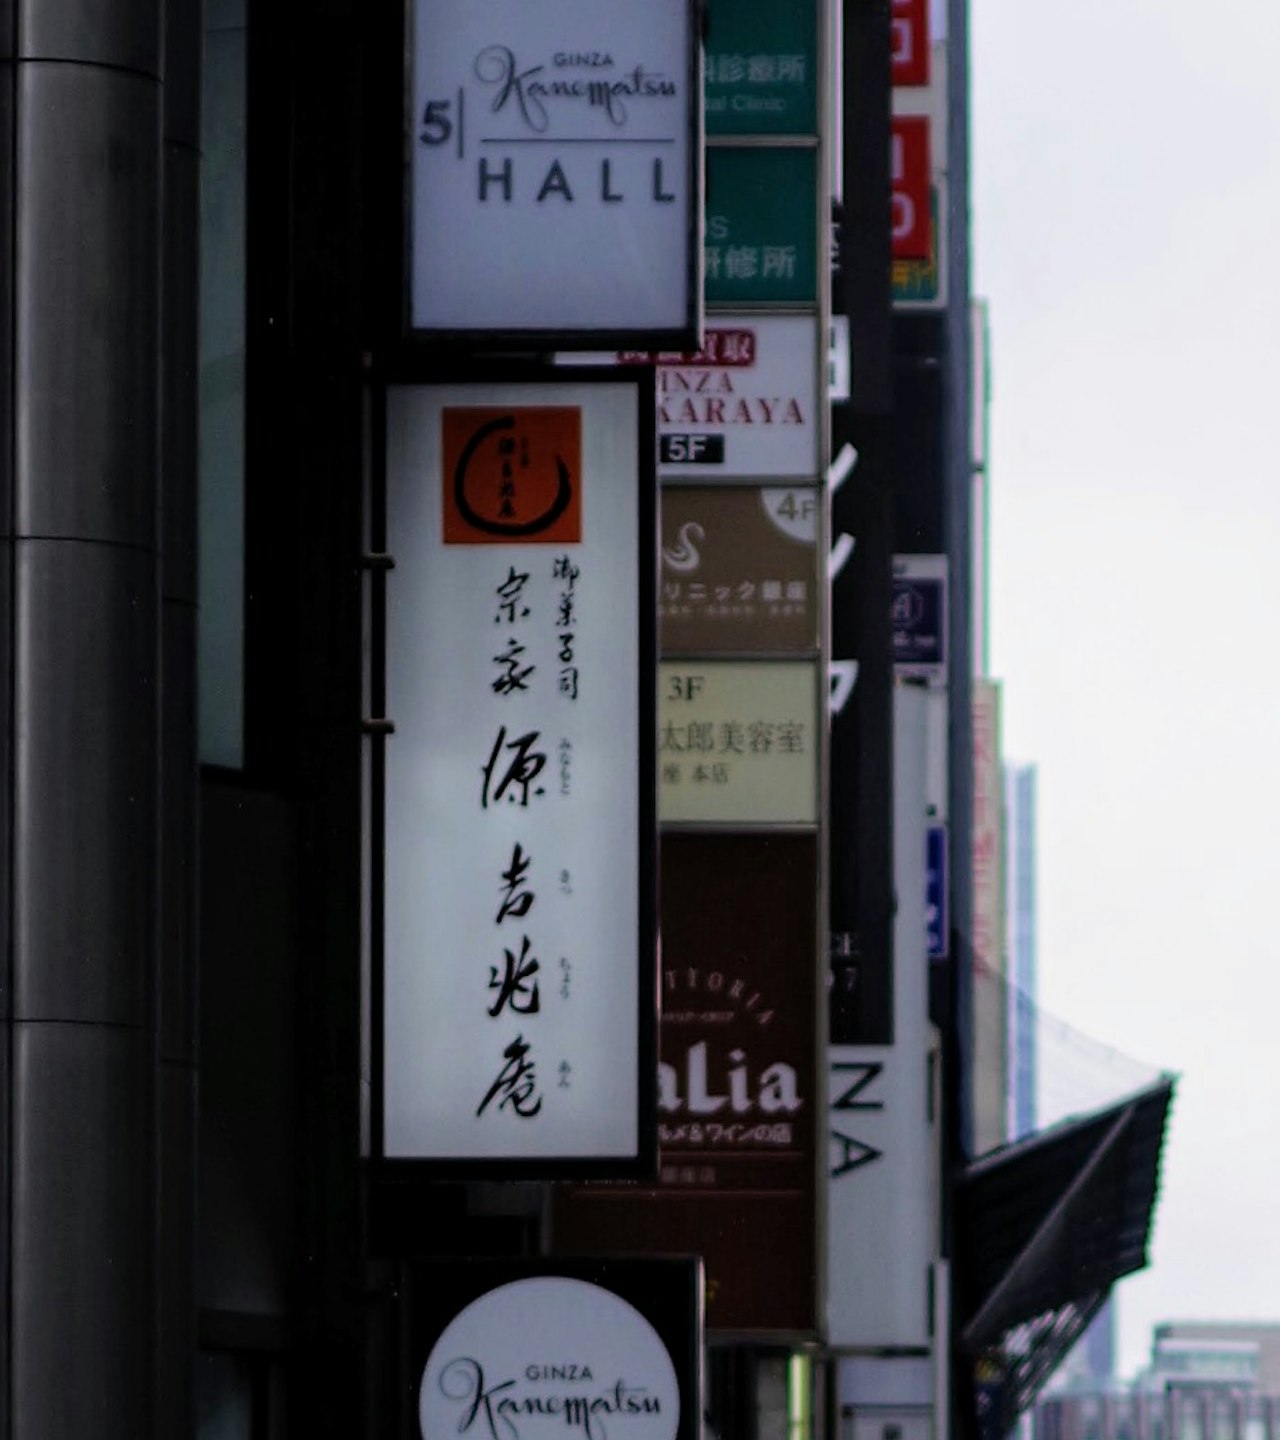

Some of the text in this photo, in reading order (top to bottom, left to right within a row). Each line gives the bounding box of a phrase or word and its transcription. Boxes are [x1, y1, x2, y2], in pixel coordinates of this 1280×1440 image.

[554, 52, 614, 67] GINZA
[475, 44, 677, 134] Kanematsu
[420, 98, 453, 145] 5
[478, 157, 676, 203] HALL
[661, 371, 734, 393] INZA
[668, 434, 708, 461] 5F
[668, 675, 705, 701] 3F
[525, 1364, 593, 1381] GINZA
